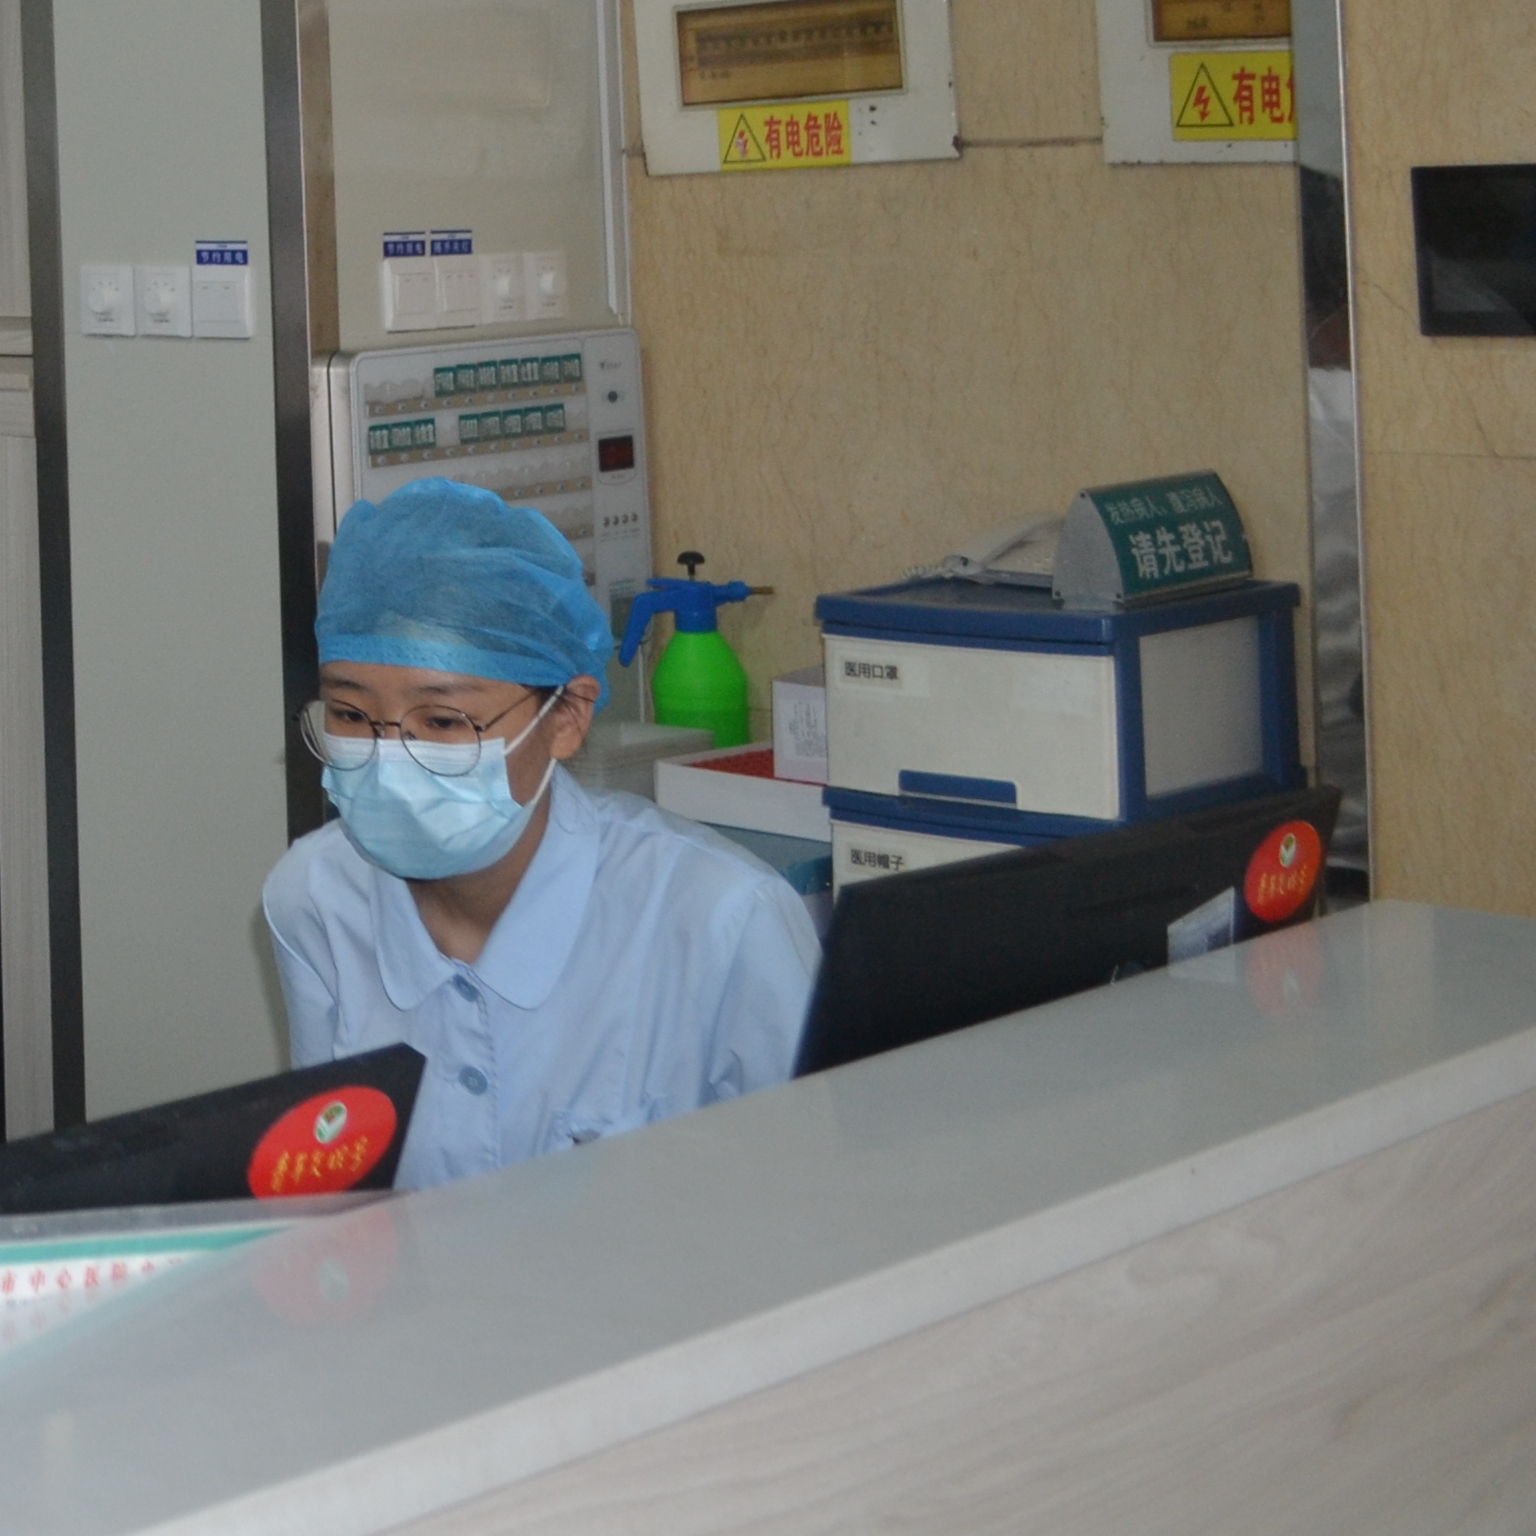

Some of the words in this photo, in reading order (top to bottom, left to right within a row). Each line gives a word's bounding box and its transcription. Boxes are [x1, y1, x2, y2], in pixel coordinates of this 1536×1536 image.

[1231, 66, 1296, 126] 有电
[763, 110, 844, 159] 有电危险
[1129, 519, 1234, 580] 请先登记
[844, 661, 899, 680] 医用口罩
[850, 848, 905, 872] 医用帽子
